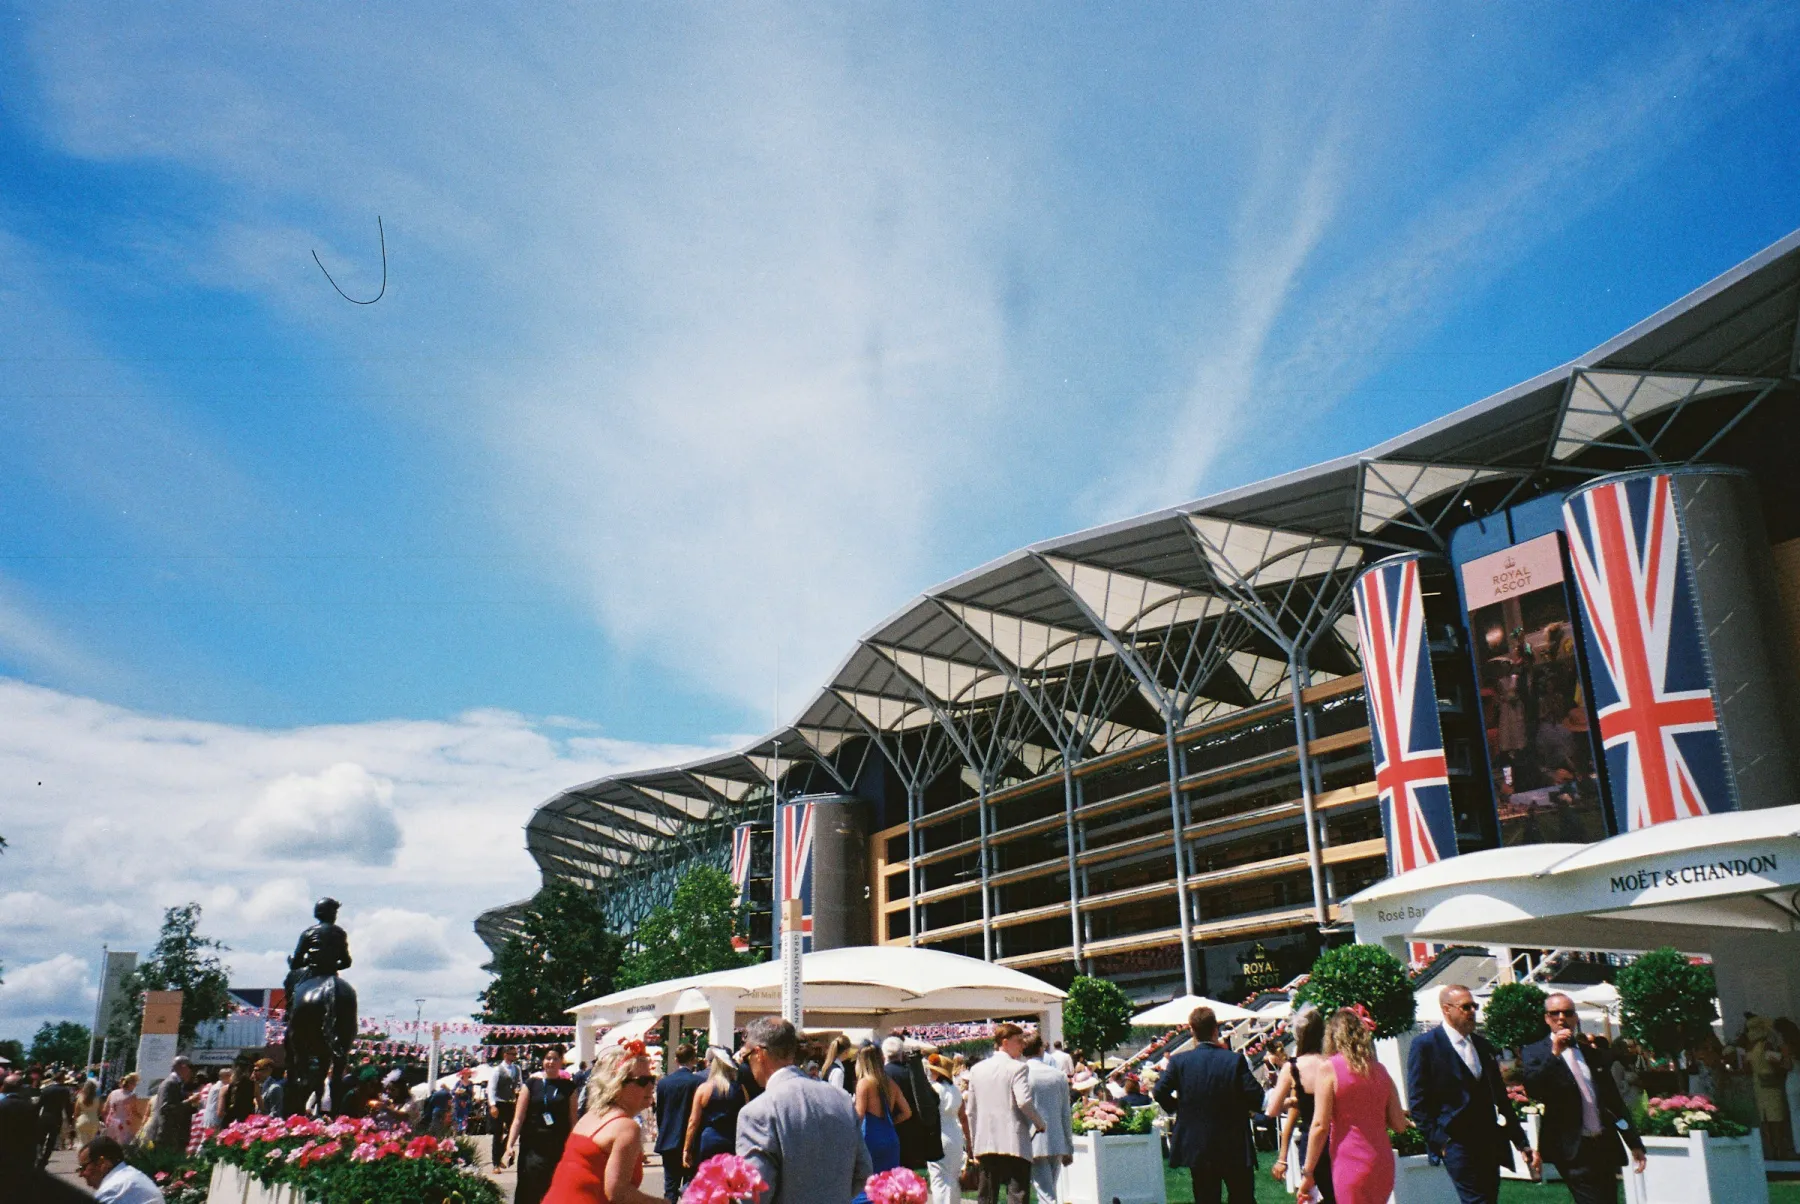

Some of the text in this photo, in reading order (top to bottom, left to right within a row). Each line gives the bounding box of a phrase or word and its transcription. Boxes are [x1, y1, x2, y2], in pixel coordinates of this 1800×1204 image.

[1493, 567, 1531, 585] ROYAL
[1495, 576, 1531, 596] ASCOT
[1610, 854, 1778, 893] MOËT & CHANDON
[1378, 906, 1426, 922] Rosé Bar
[1243, 961, 1280, 975] ROYAL
[1246, 973, 1280, 987] ASCOT
